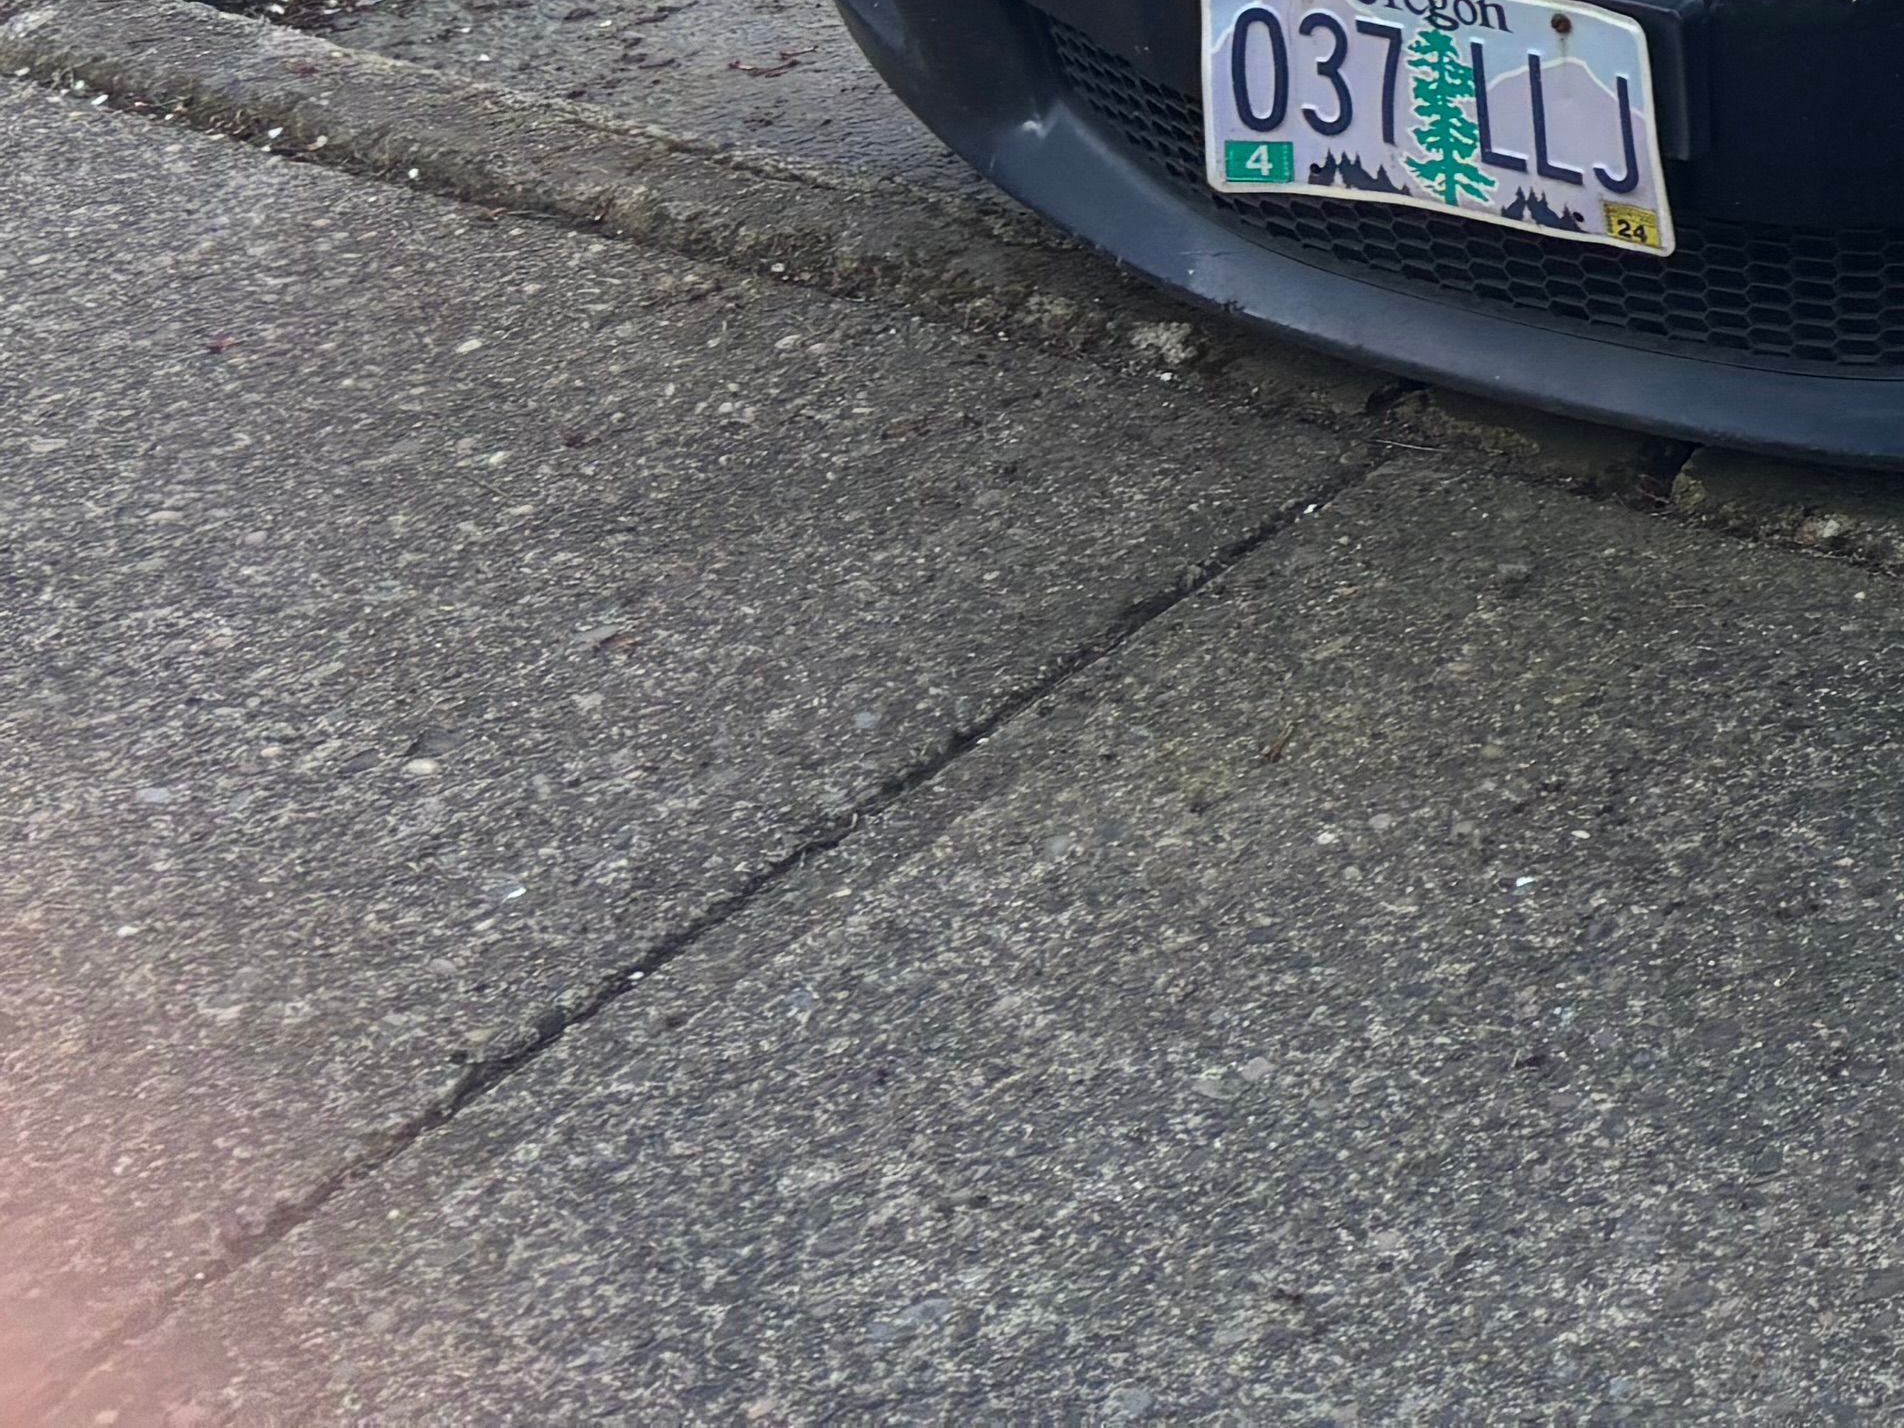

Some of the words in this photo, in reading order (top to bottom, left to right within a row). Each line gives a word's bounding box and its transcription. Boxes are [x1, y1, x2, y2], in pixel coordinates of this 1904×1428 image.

[1231, 6, 1403, 146] 037
[1469, 38, 1640, 193] LLJ
[1245, 143, 1274, 176] 4
[1616, 218, 1649, 244] 24
